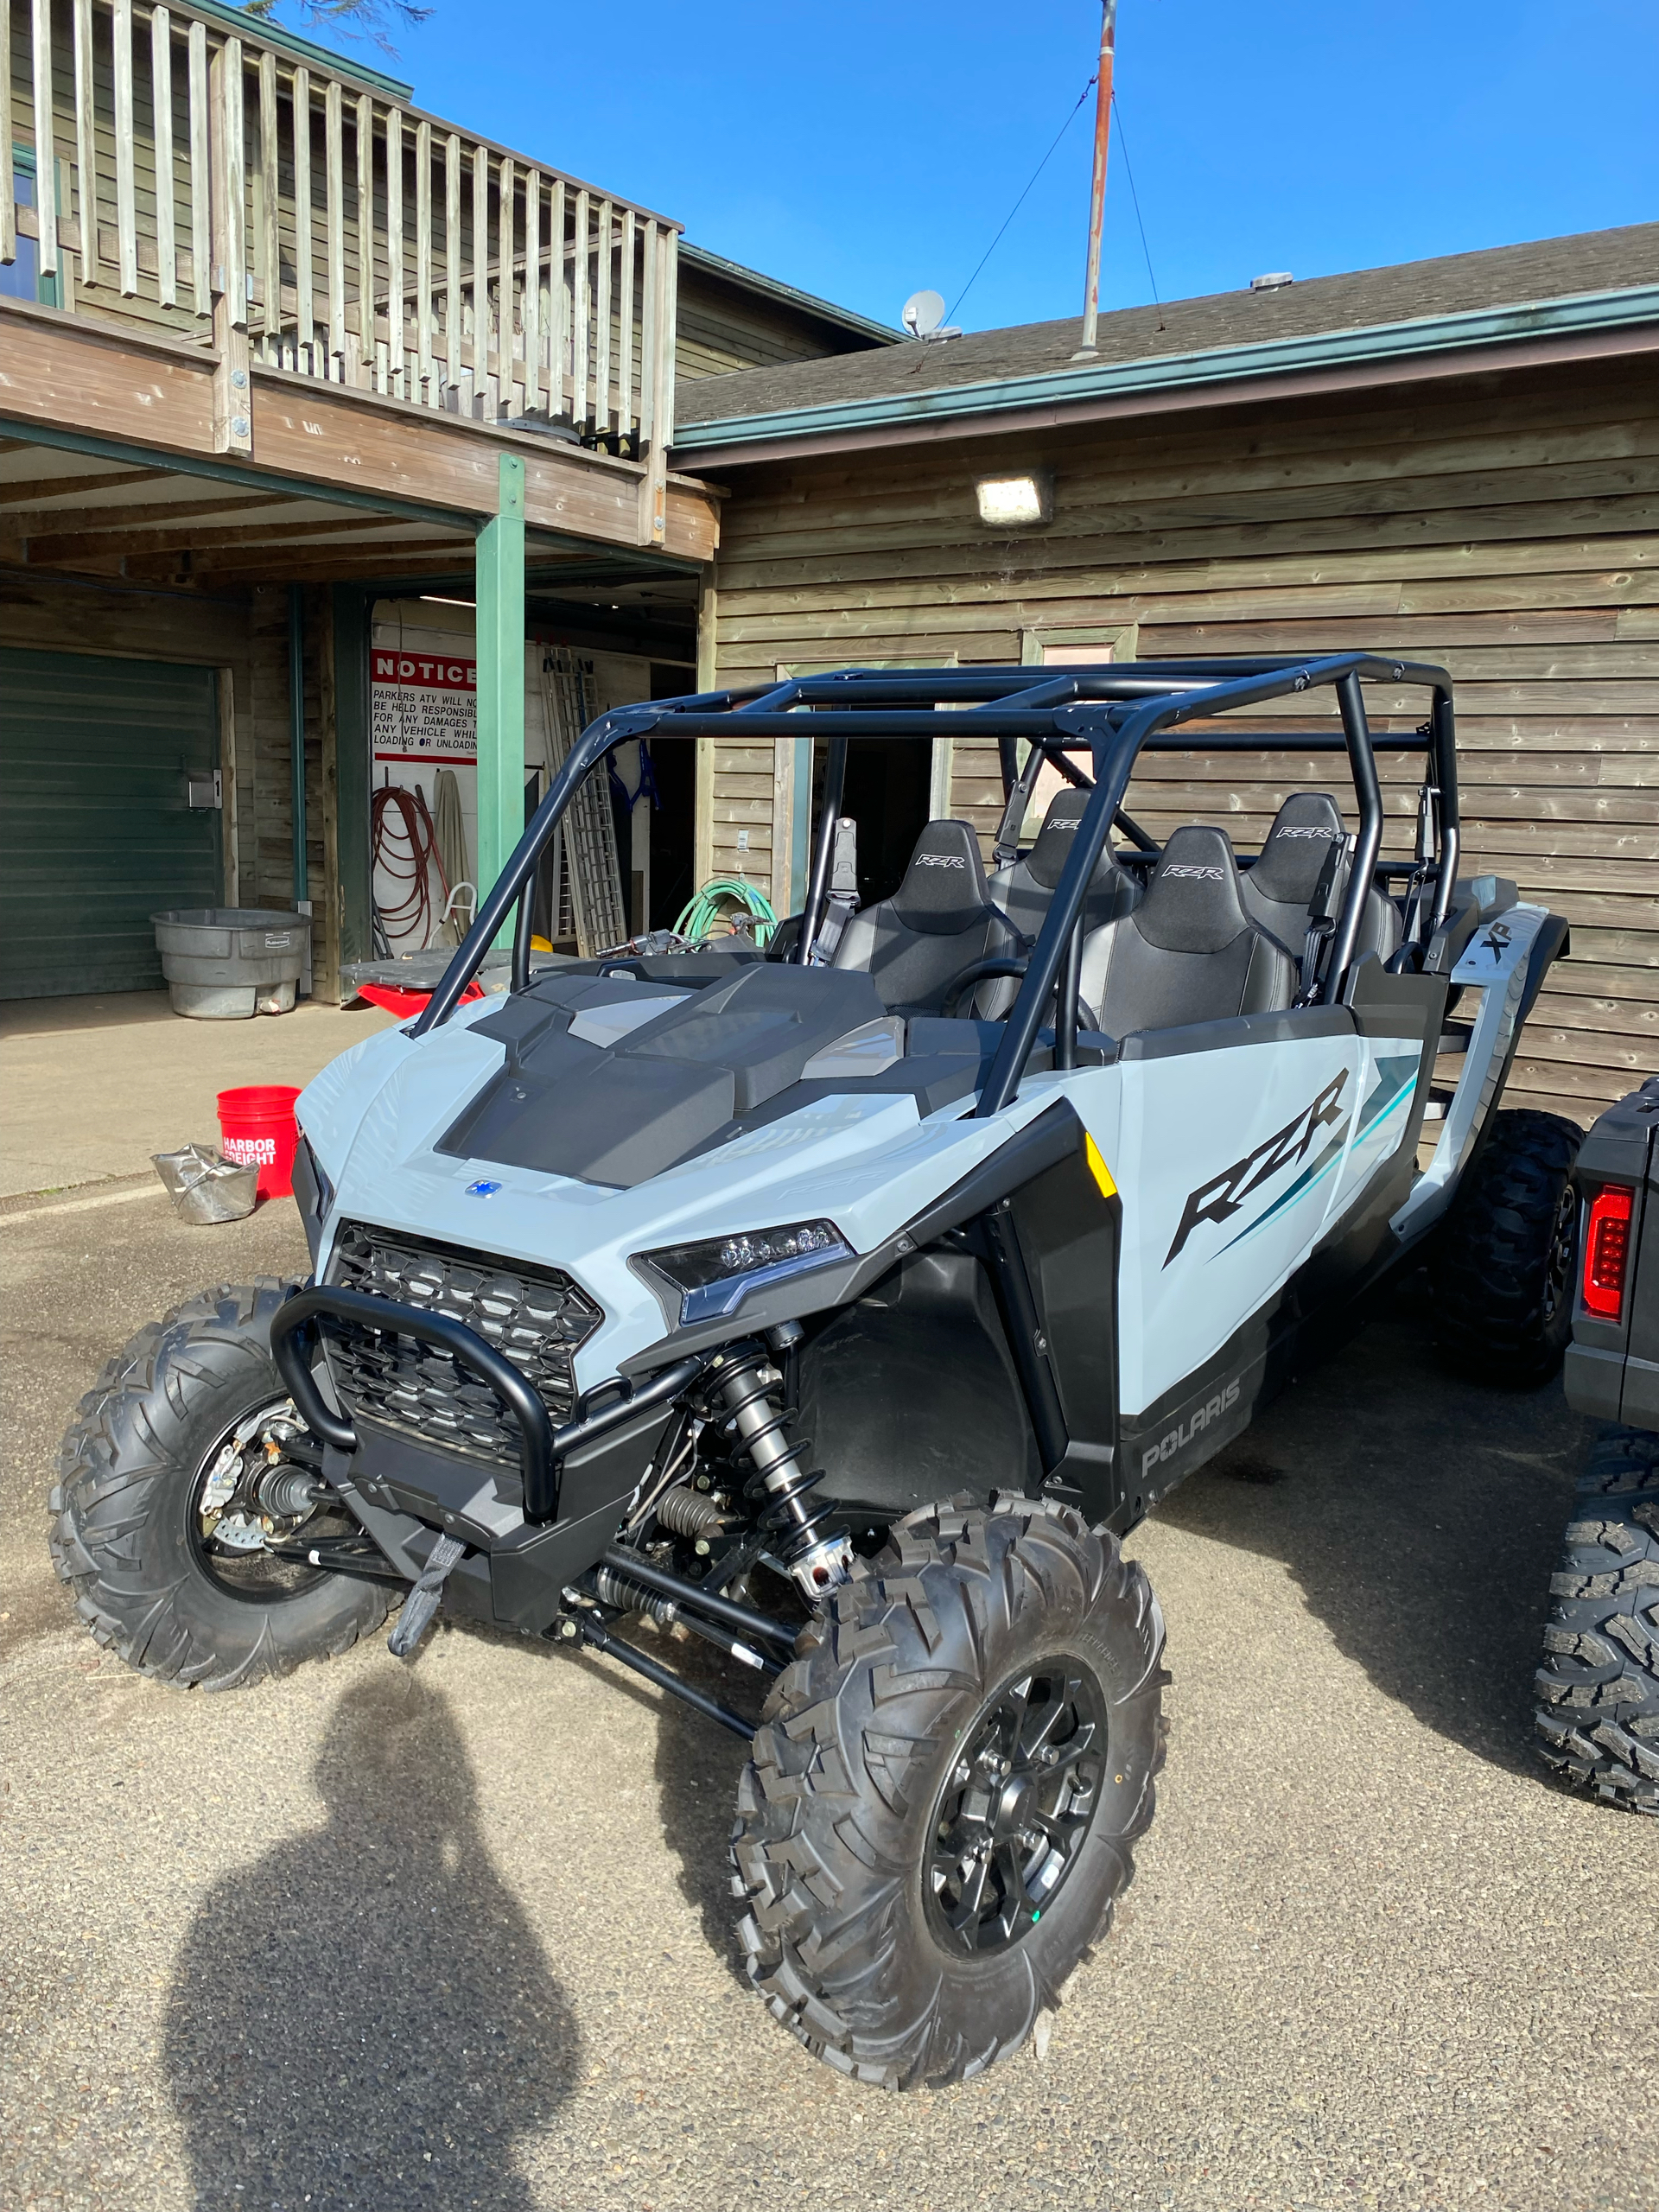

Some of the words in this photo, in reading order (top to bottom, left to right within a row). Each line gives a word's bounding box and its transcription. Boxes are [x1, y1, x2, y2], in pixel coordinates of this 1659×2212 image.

[377, 658, 477, 683] NOTICE
[373, 690, 415, 702] PARKERS
[419, 694, 437, 703] ATV
[442, 696, 461, 706] WILL
[467, 698, 477, 708] NO
[373, 701, 386, 710] BE
[392, 702, 416, 713] HELD
[422, 705, 477, 718] RESPONSIBL
[373, 712, 393, 722] FOR
[398, 715, 418, 724] ANY
[424, 716, 467, 728] DAMAGES
[374, 723, 397, 734] ANY
[404, 726, 446, 737] VEHICLE
[454, 729, 477, 740] WHIL
[373, 734, 414, 746] LOADING
[419, 738, 431, 747] OR
[436, 739, 477, 750] UNLOADIN
[1047, 818, 1082, 830] RZ
[1275, 826, 1332, 839] RZR
[915, 854, 965, 868] RZR
[1161, 865, 1224, 880] RZR
[1480, 921, 1512, 965] XP
[223, 1135, 276, 1153] HARBOR
[1160, 1066, 1350, 1273] RZR
[1141, 1376, 1241, 1479] POLARIS
